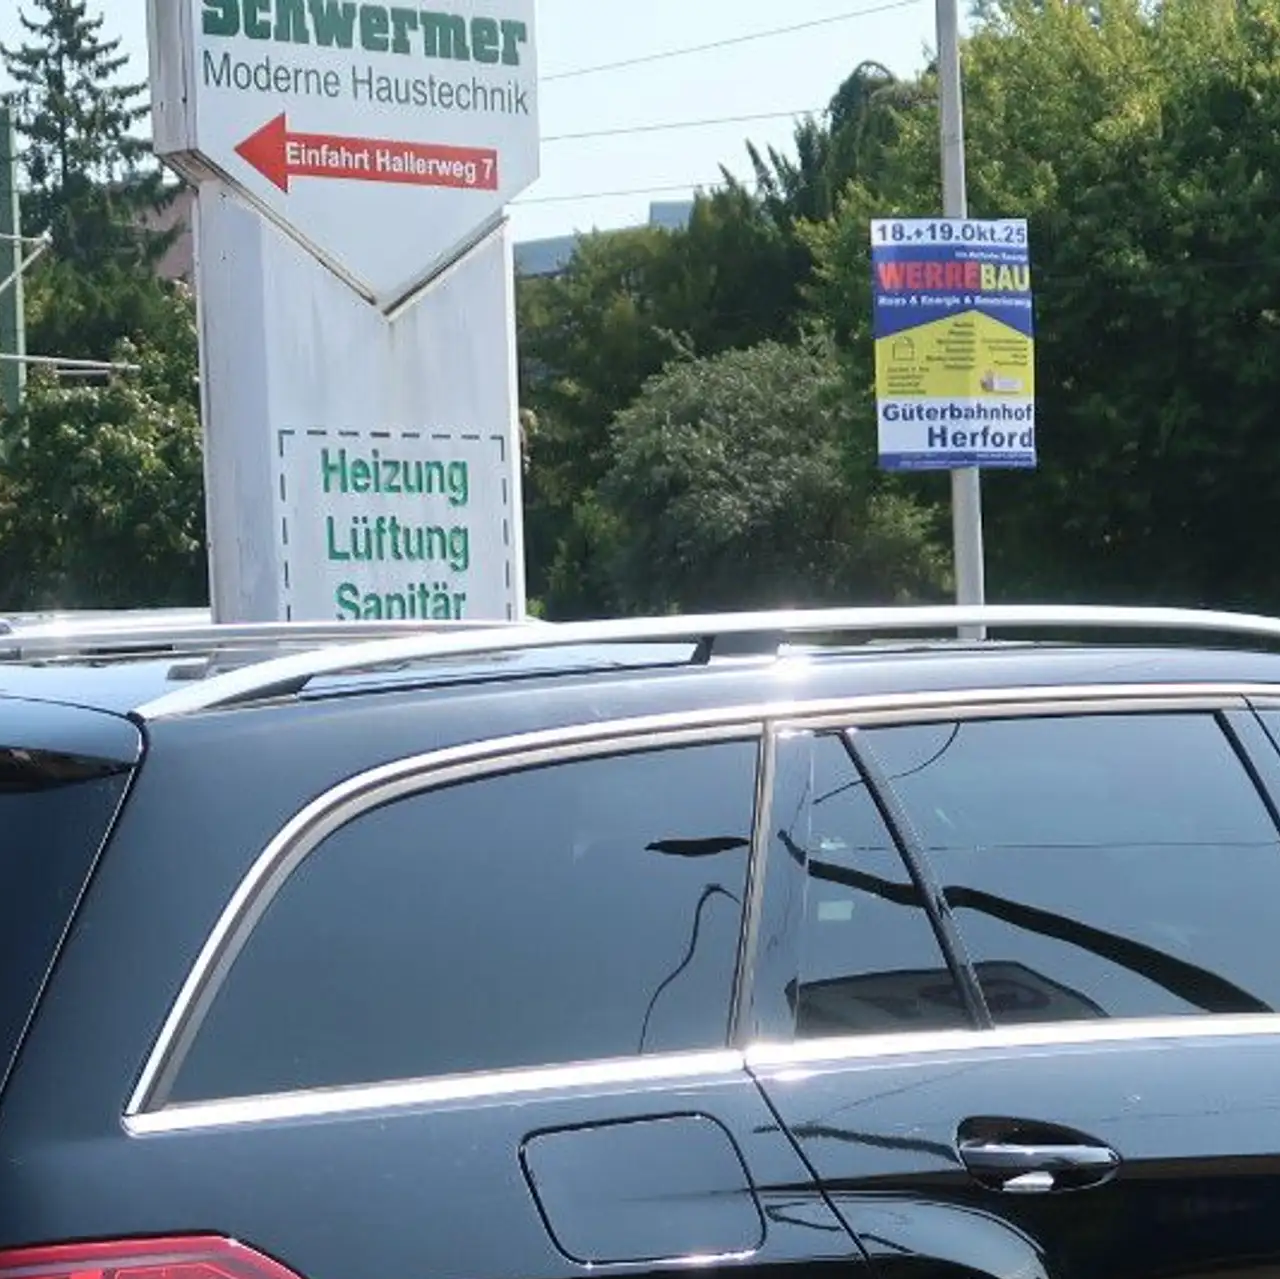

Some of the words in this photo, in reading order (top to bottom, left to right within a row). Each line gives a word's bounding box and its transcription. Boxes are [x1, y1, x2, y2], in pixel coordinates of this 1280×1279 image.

[203, 50, 340, 98] Moderne
[352, 65, 529, 115] Haustechnik
[285, 141, 370, 170] Einfahrt
[376, 149, 476, 184] Hallerweg
[482, 158, 493, 179] 7
[883, 403, 1032, 421] Güterbahnhof
[928, 425, 1033, 447] Herford
[321, 448, 468, 506] Heizung
[326, 516, 468, 571] Lüftung
[335, 582, 466, 620] Sanitär
